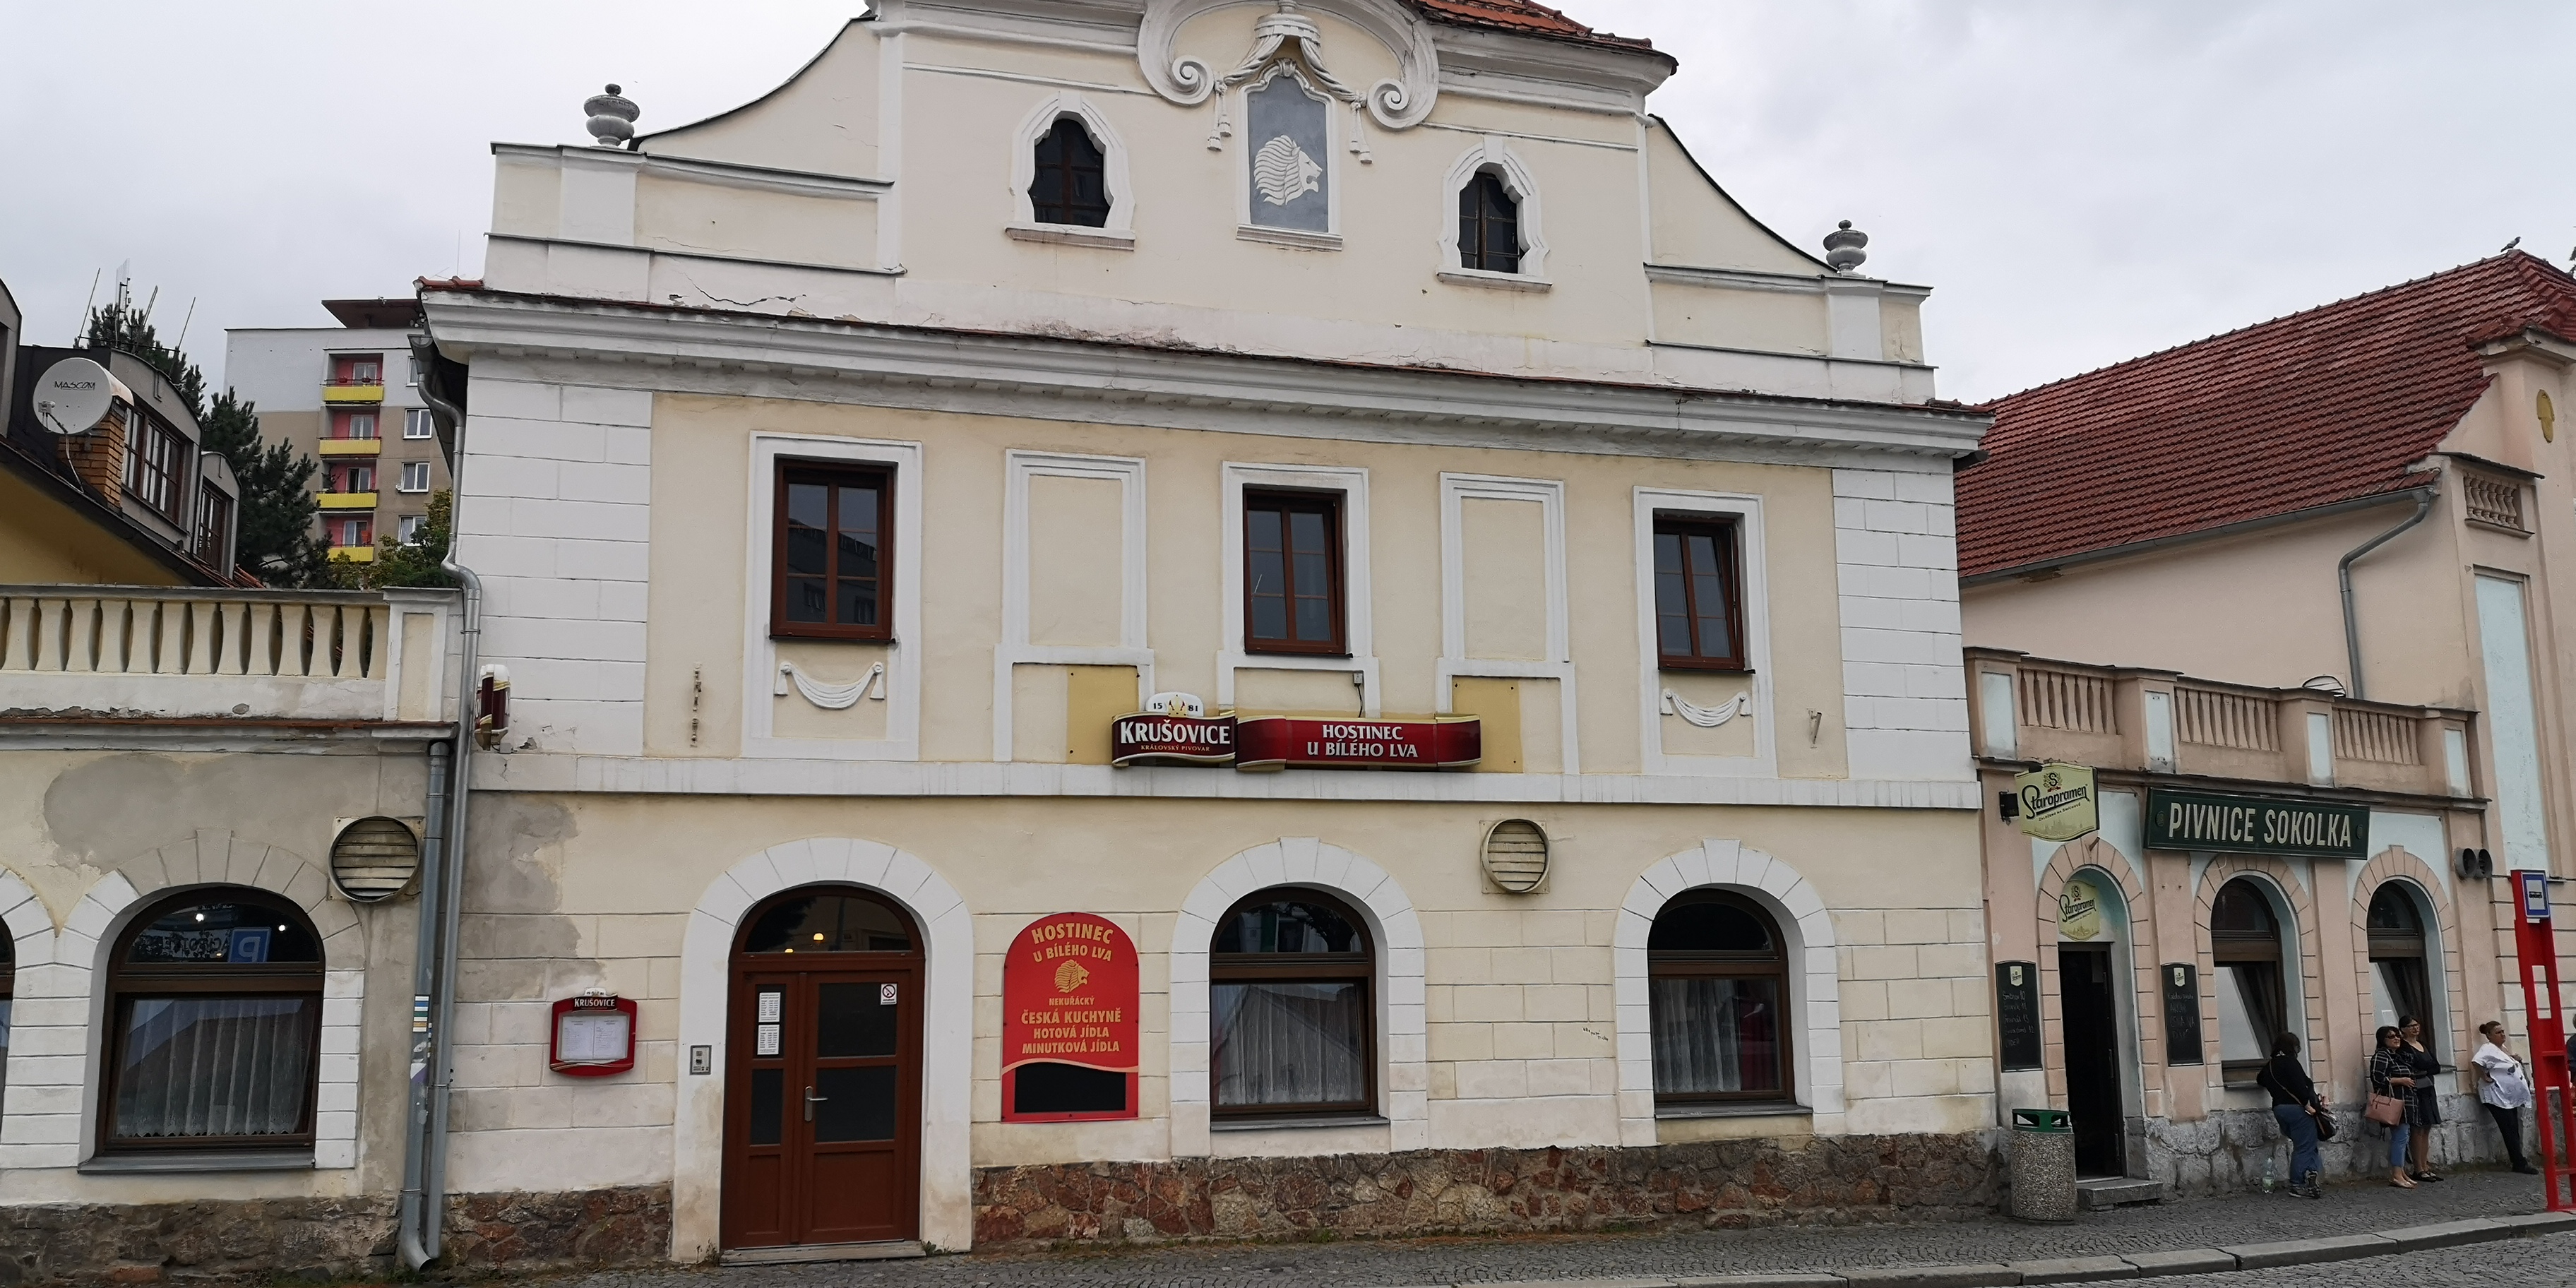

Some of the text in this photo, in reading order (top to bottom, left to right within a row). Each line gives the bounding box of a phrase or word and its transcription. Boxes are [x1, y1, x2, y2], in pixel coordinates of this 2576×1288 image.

[54, 381, 95, 390] MASCOM
[1120, 719, 1231, 745] KRUŠOVICE
[1322, 724, 1404, 740] HOSTINEC
[1307, 739, 1419, 758] U BÍLÉHO LVA
[2022, 785, 2091, 820] Staropramen
[2169, 802, 2351, 847] PIVNICE SOKOLKA
[2058, 894, 2097, 922] Staropramen
[1031, 922, 1114, 945] HOSTINEC
[1032, 941, 1112, 962] U BÍLÉHO LVA
[574, 997, 615, 1008] KRUŠOVICE
[1049, 995, 1095, 1006] NEKUŘÁCKÝ
[1021, 1007, 1121, 1025] ČESKÁ KUCHYNĚ
[1033, 1024, 1109, 1039] HOTOVÁ JÍDLA
[1022, 1039, 1120, 1054] MINUTKOVÁ JÍDLA
